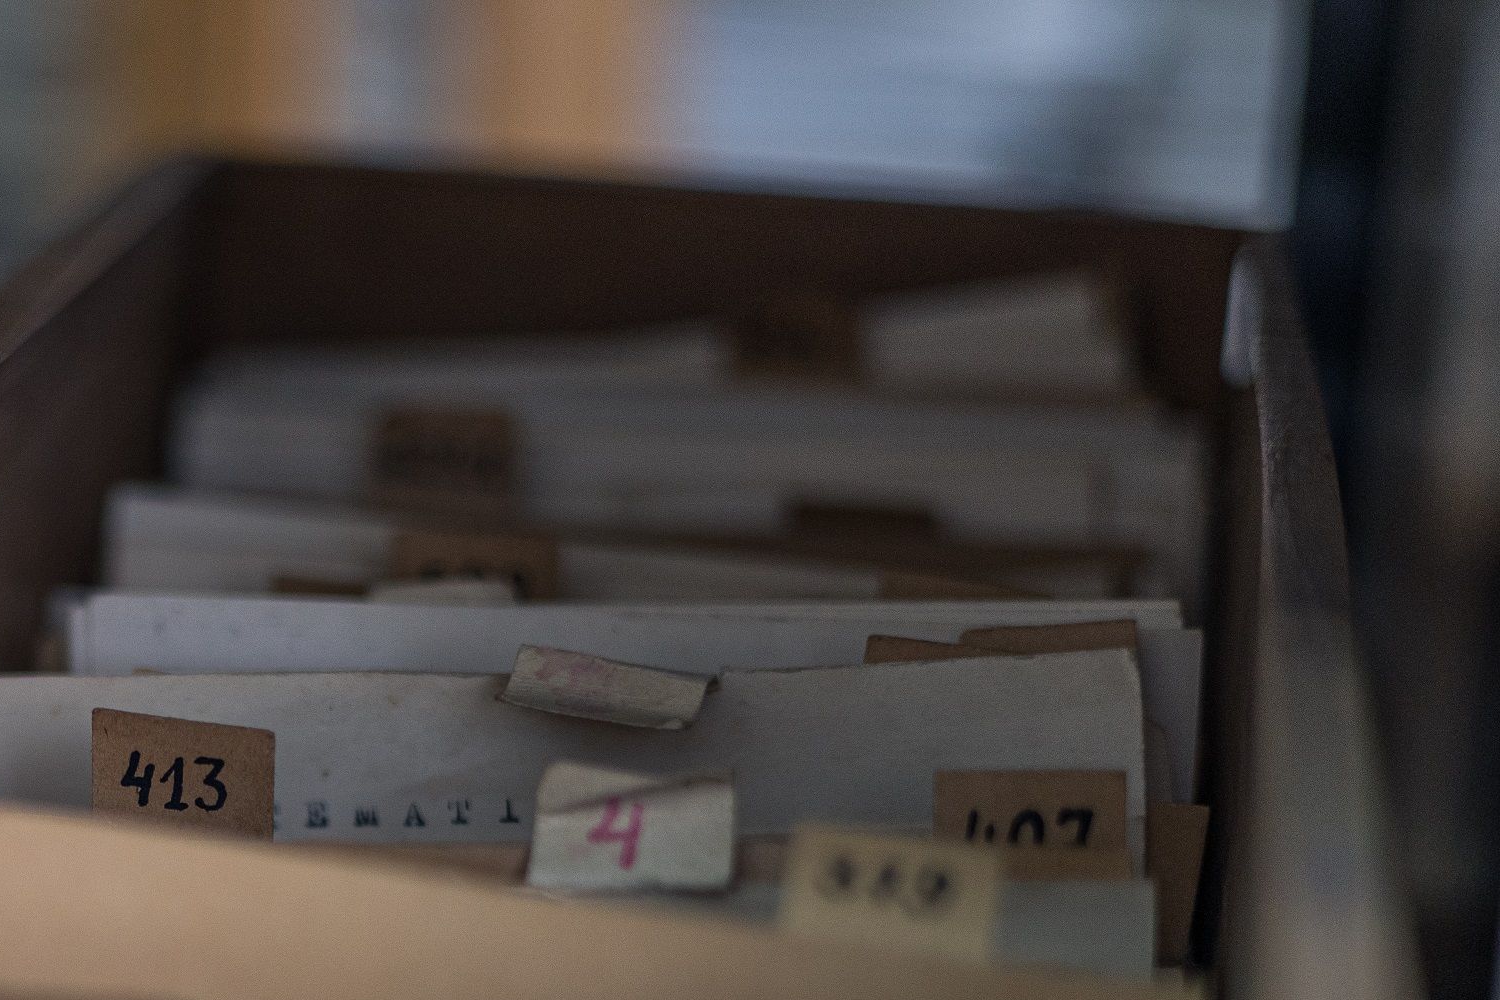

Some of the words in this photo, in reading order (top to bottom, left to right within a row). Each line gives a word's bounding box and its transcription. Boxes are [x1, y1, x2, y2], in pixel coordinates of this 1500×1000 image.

[120, 750, 228, 811] 413
[275, 797, 522, 828] EMATI
[587, 793, 644, 871] 4
